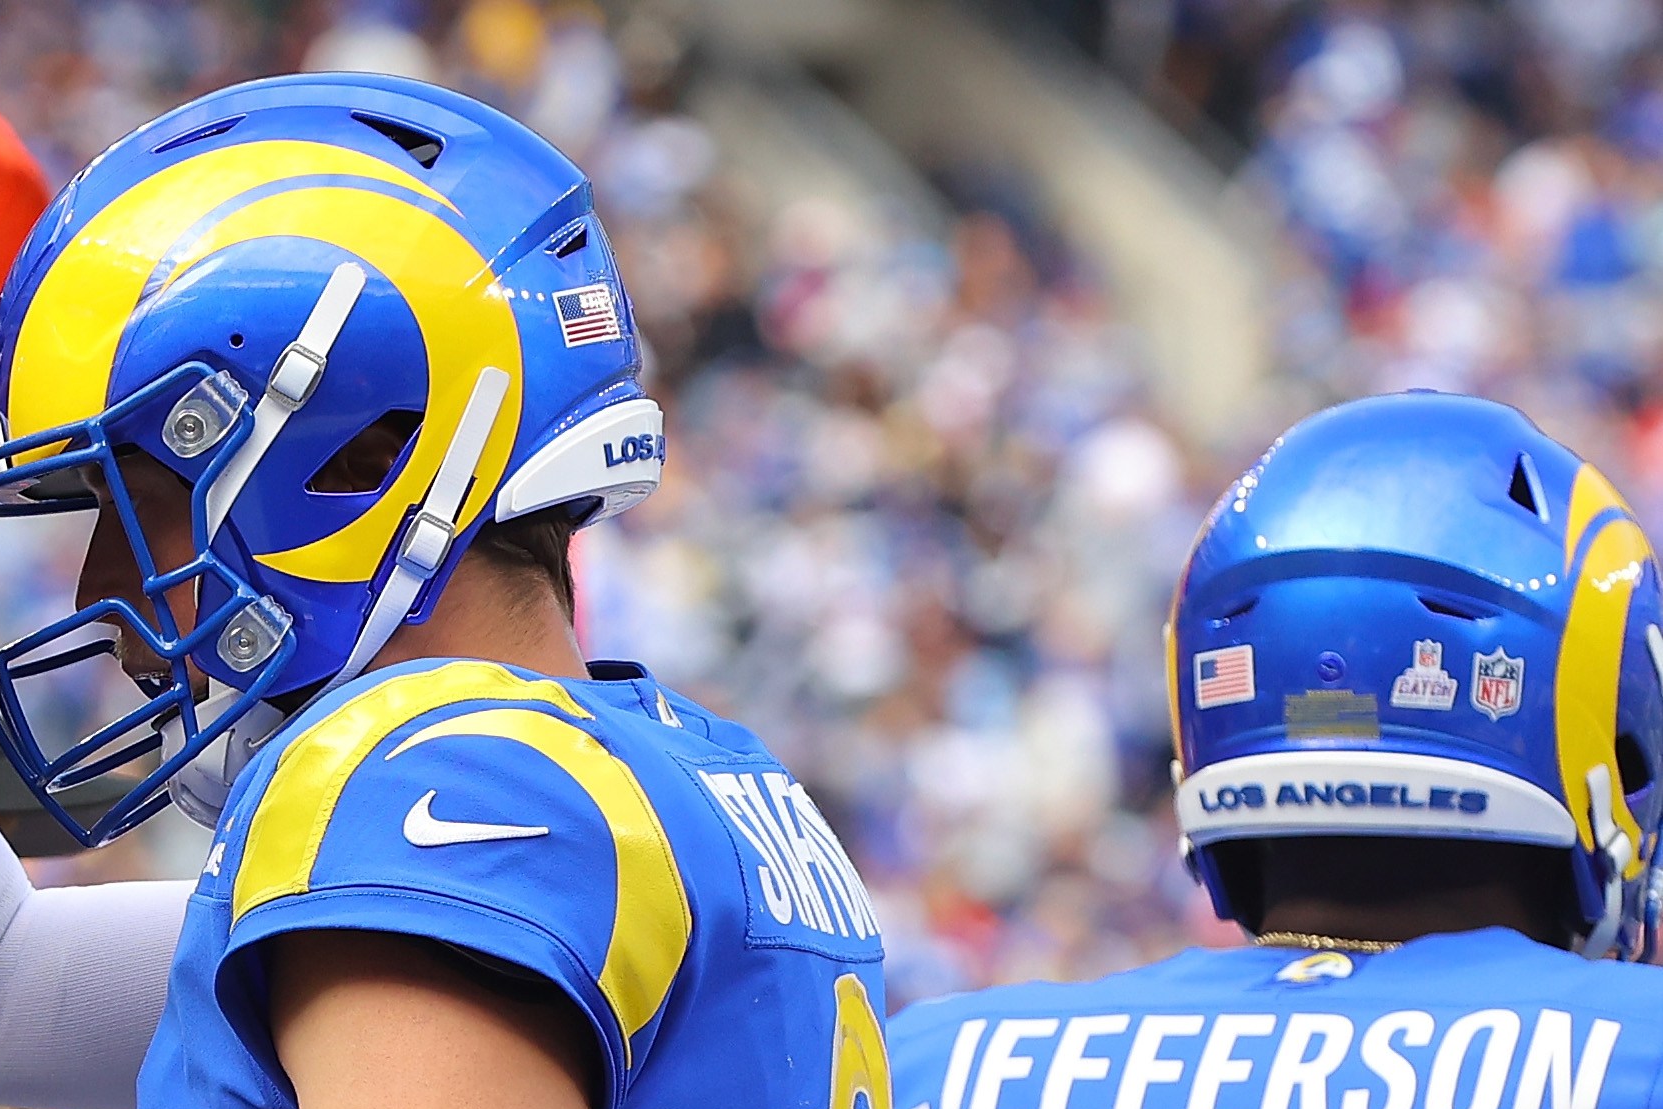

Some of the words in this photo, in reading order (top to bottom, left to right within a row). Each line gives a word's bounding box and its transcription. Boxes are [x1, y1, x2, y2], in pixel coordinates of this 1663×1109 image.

[603, 433, 654, 468] LOS
[1479, 678, 1515, 709] NFL
[1199, 783, 1265, 813] LOS
[1275, 780, 1490, 815] ANGELES
